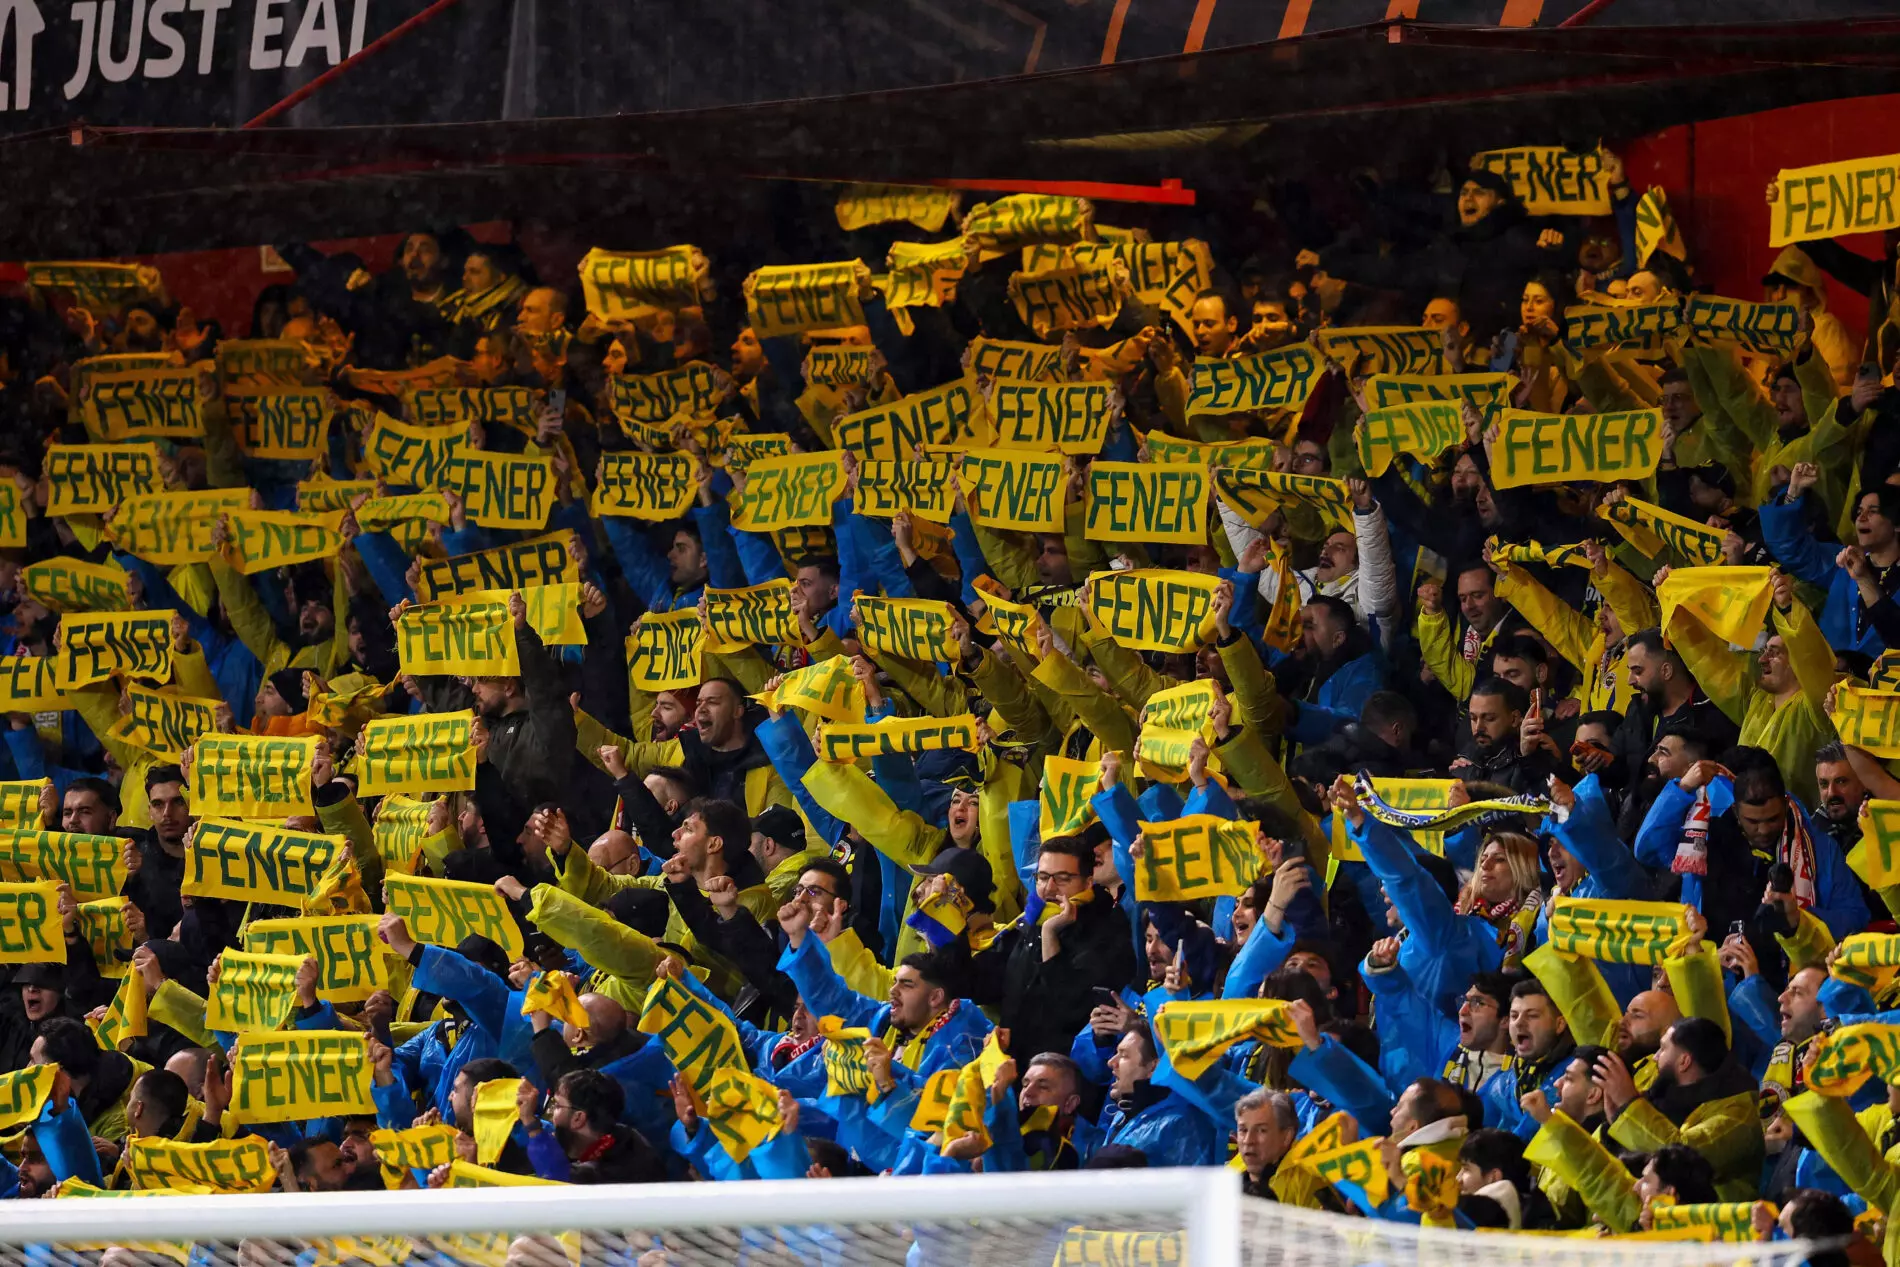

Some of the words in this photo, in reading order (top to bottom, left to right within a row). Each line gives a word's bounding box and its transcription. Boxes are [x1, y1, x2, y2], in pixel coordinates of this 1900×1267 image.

[63, 0, 232, 101] JUST
[1784, 167, 1896, 238] FENER
[752, 270, 860, 327] FENER
[93, 377, 198, 432] FENER
[612, 366, 716, 422] FENER
[1187, 350, 1314, 408] FENER
[225, 395, 323, 448] FENER
[838, 385, 975, 460] FENER
[996, 386, 1107, 442] FENER
[1362, 406, 1460, 470] FENER
[1505, 413, 1657, 477] FENER
[50, 452, 154, 505] FENER
[446, 458, 548, 520] FENER
[602, 455, 691, 509] FENER
[734, 462, 838, 523] FENER
[857, 459, 948, 512] FENER
[962, 459, 1061, 522] FENER
[1088, 471, 1202, 533] FENER
[423, 541, 566, 601] FENER
[403, 604, 508, 663] FENER
[707, 587, 792, 645] FENER
[856, 598, 947, 661] FENER
[1093, 576, 1211, 648] FENER
[67, 619, 172, 681] FENER
[120, 692, 214, 752] FENER
[365, 717, 470, 784] FENER
[198, 740, 306, 804] FENER
[194, 823, 335, 896] FENER
[387, 880, 512, 951] FENER
[1552, 907, 1680, 965] FENER
[239, 1038, 364, 1110] FENER
